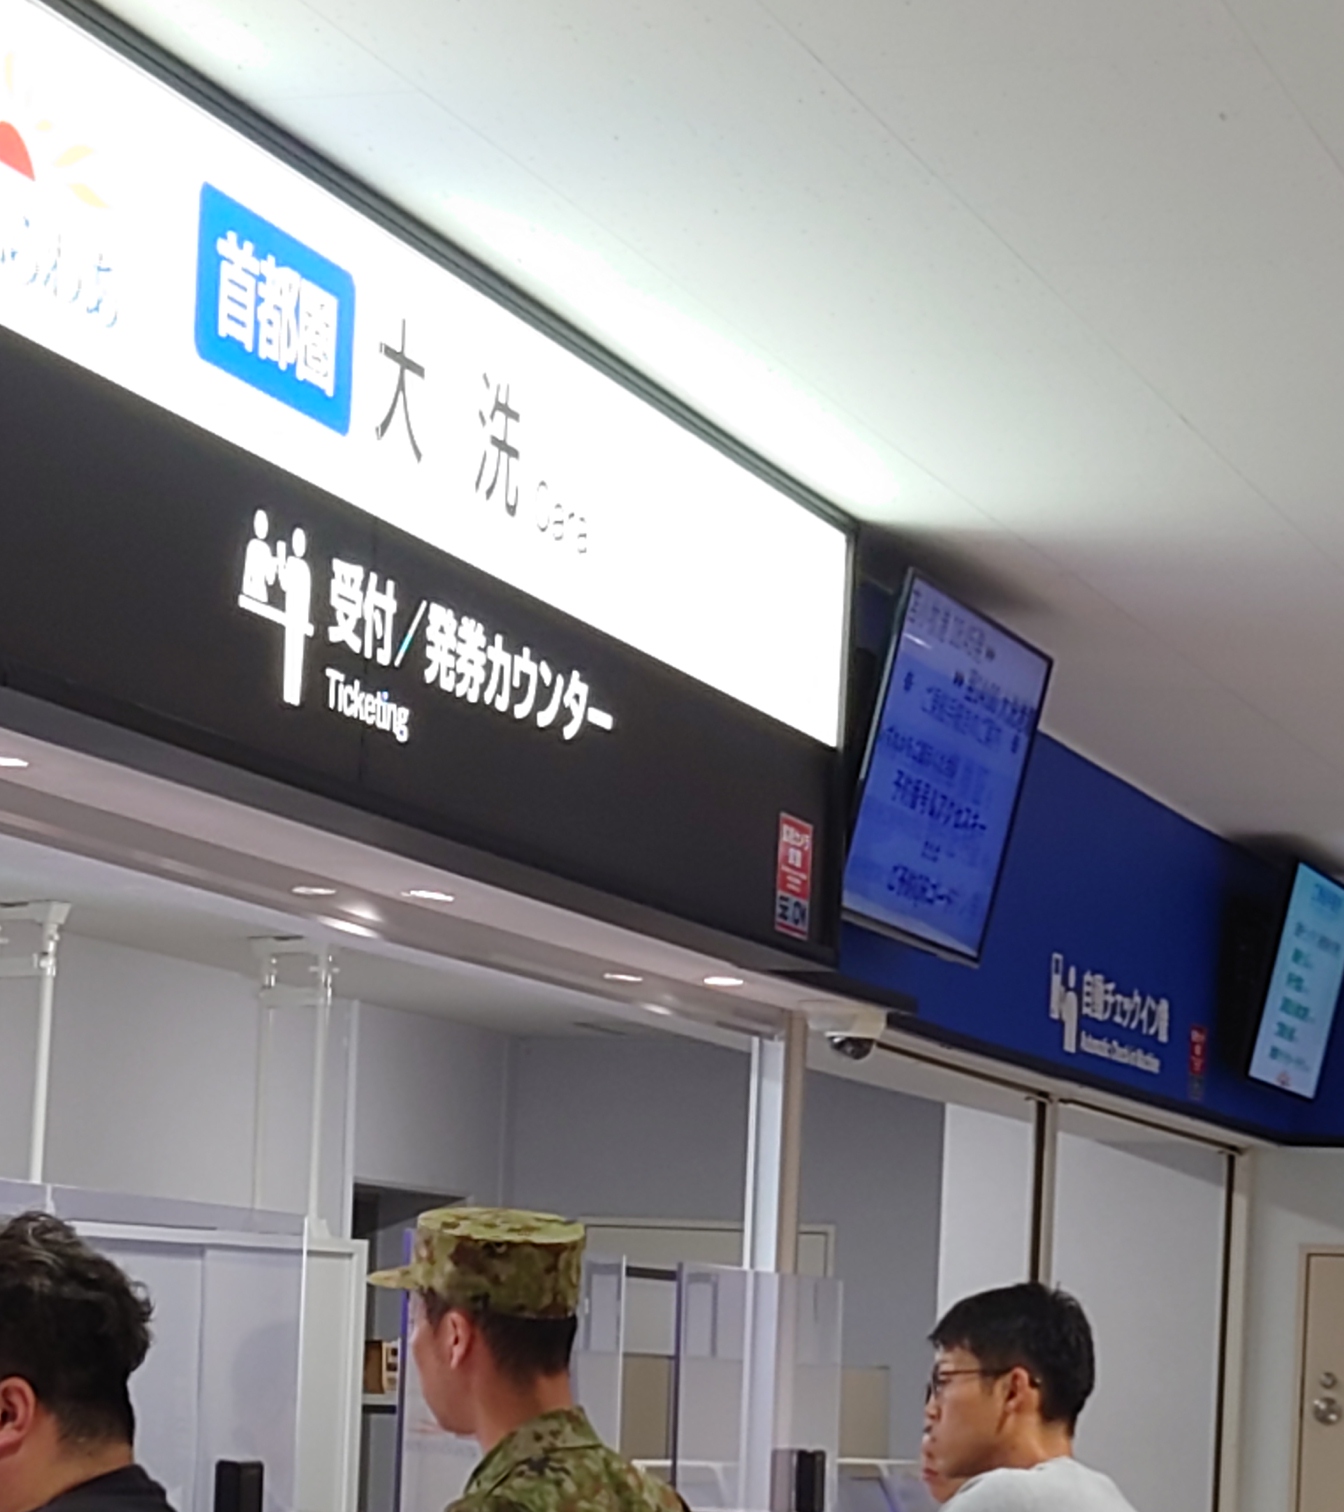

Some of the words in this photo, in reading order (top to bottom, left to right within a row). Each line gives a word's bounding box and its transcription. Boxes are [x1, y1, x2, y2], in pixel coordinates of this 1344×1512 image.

[215, 229, 340, 399] 首都圏
[374, 317, 521, 518] 大洗
[324, 667, 411, 744] Ticketing
